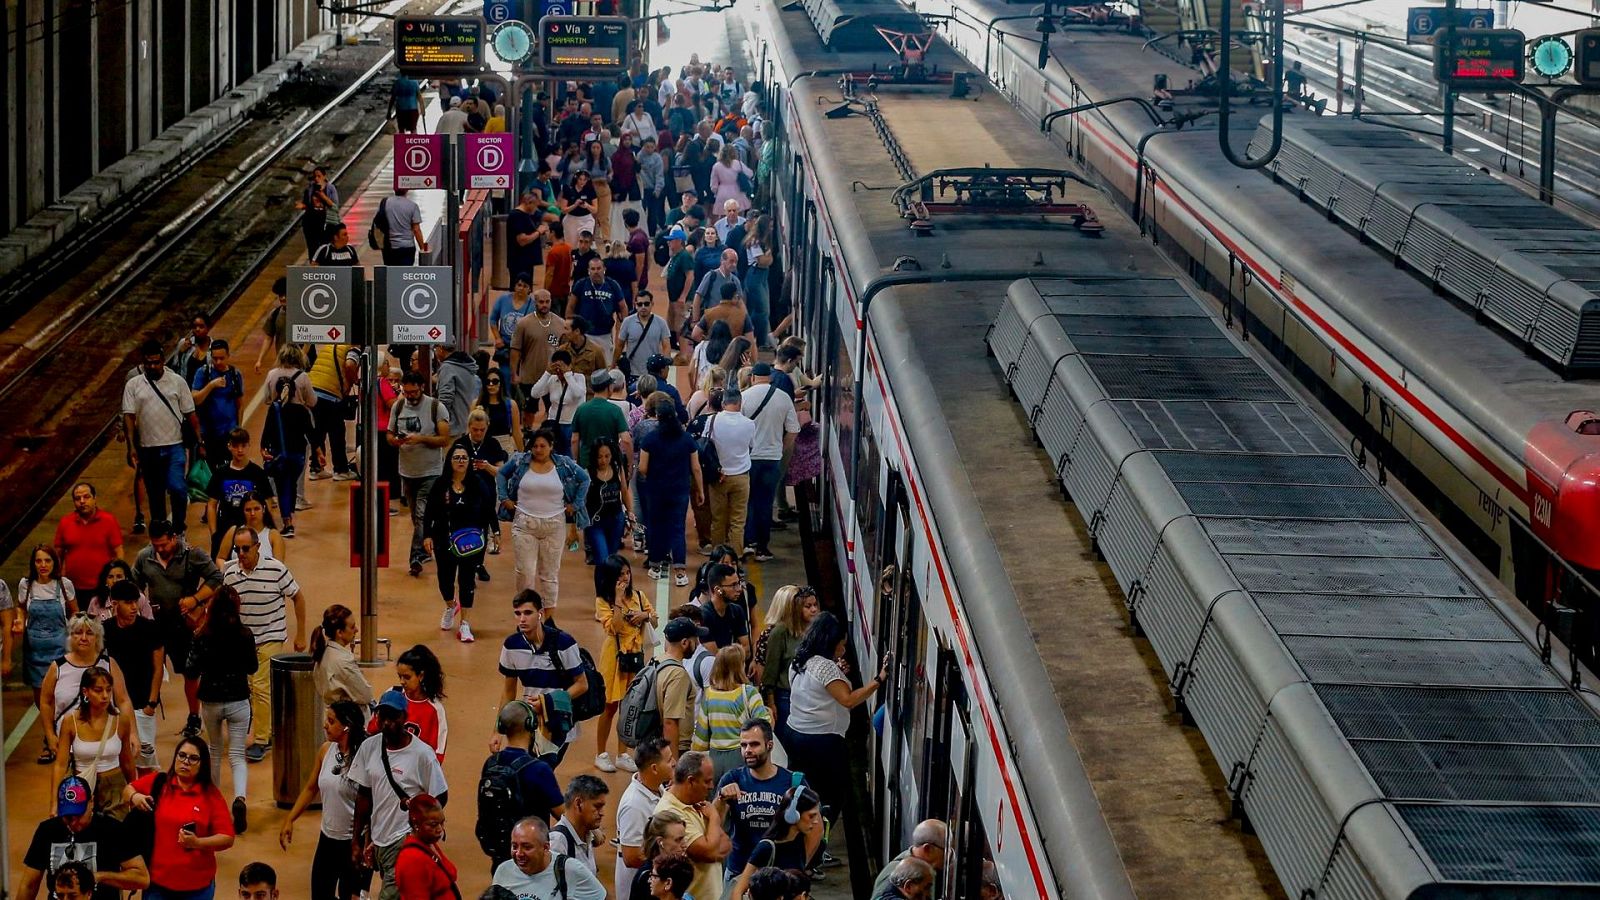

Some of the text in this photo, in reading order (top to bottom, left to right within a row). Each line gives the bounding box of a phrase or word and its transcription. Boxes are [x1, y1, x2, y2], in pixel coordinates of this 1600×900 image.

[495, 7, 504, 20] E
[440, 23, 445, 32] 1
[565, 24, 595, 34] Vía 2
[411, 149, 426, 168] D
[483, 149, 499, 167] D
[302, 273, 336, 281] SECTOR
[402, 273, 436, 281] SECTOR
[584, 290, 612, 298] COVERSE
[308, 288, 330, 314] C
[408, 288, 430, 314] C
[296, 333, 324, 342] Platform
[397, 333, 425, 342] Platform
[432, 329, 438, 339] 2
[1534, 493, 1552, 529] 123M
[757, 791, 776, 804] JONES
